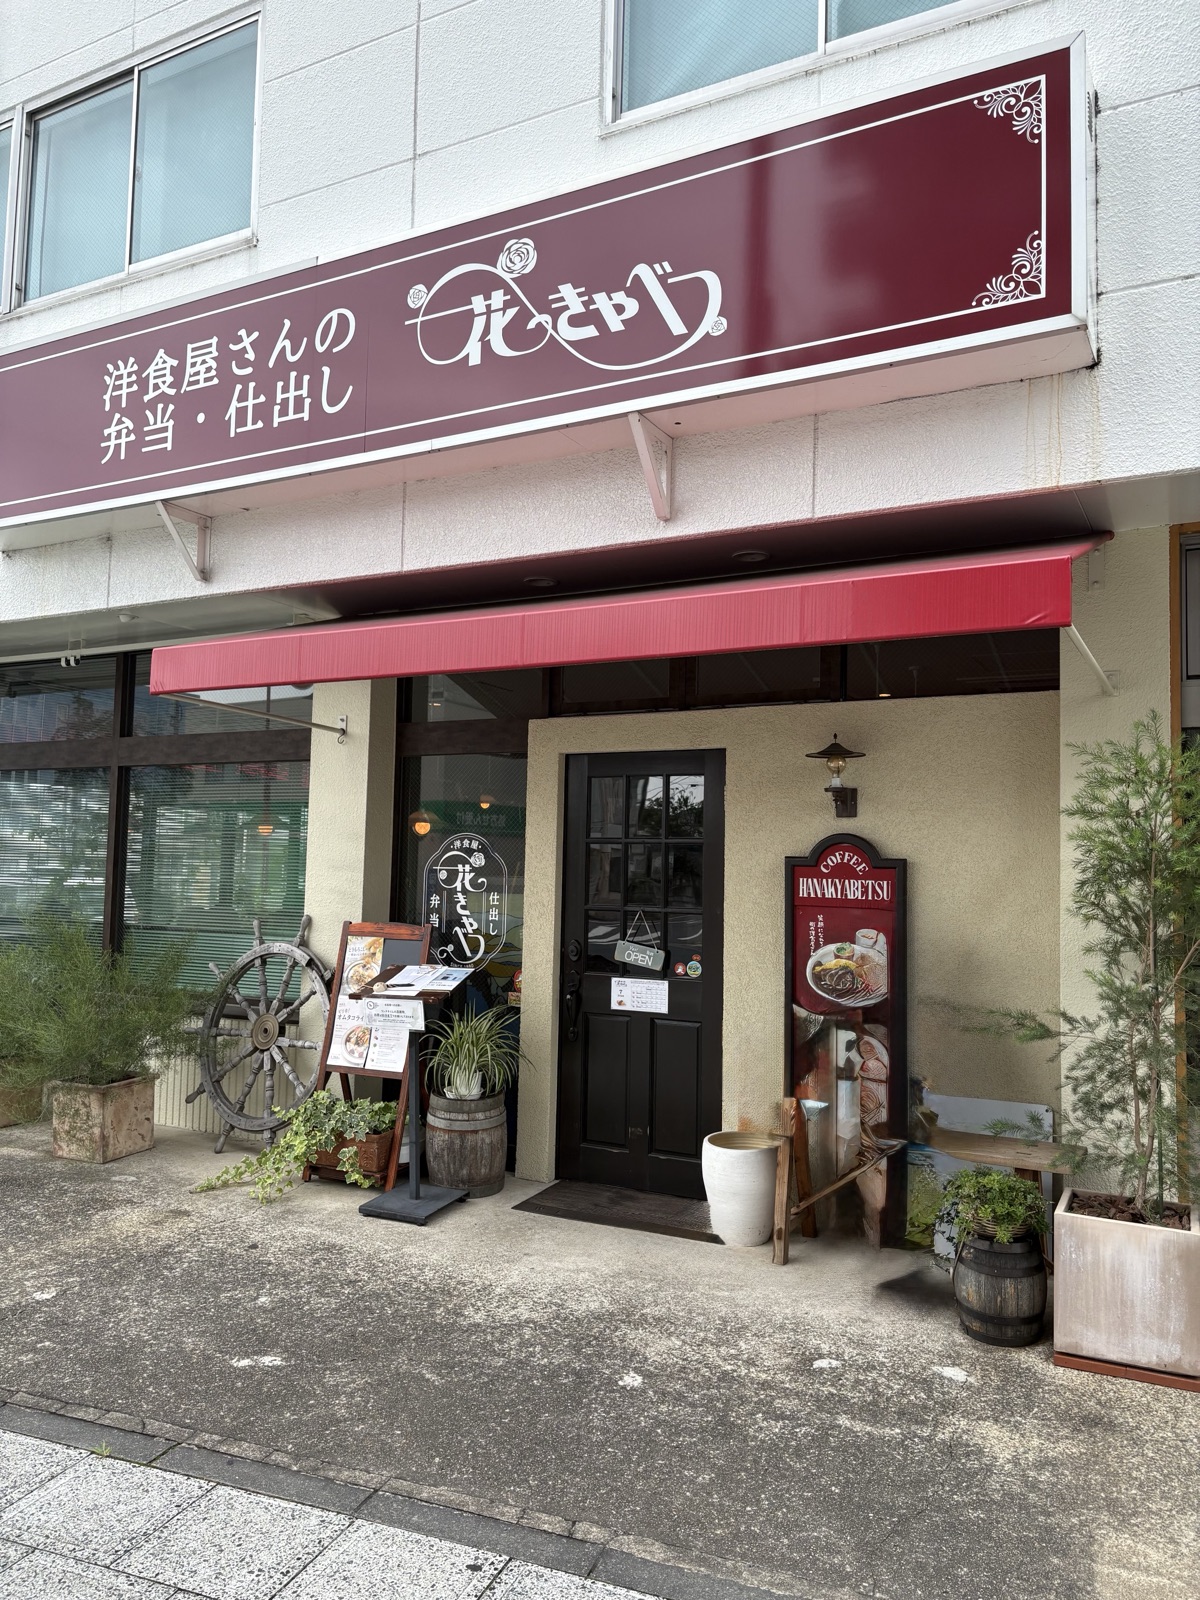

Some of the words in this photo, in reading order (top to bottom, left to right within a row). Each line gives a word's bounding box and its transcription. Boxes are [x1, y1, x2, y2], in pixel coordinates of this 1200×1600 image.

[103, 308, 356, 411] 洋食屋さんの
[101, 366, 353, 464] 弁当・仕出し
[820, 851, 869, 875] COFFEE
[799, 877, 891, 900] HANAKYABETSU
[429, 893, 440, 928] 弁当
[489, 892, 500, 936] 仕出し
[624, 950, 653, 966] OPEN
